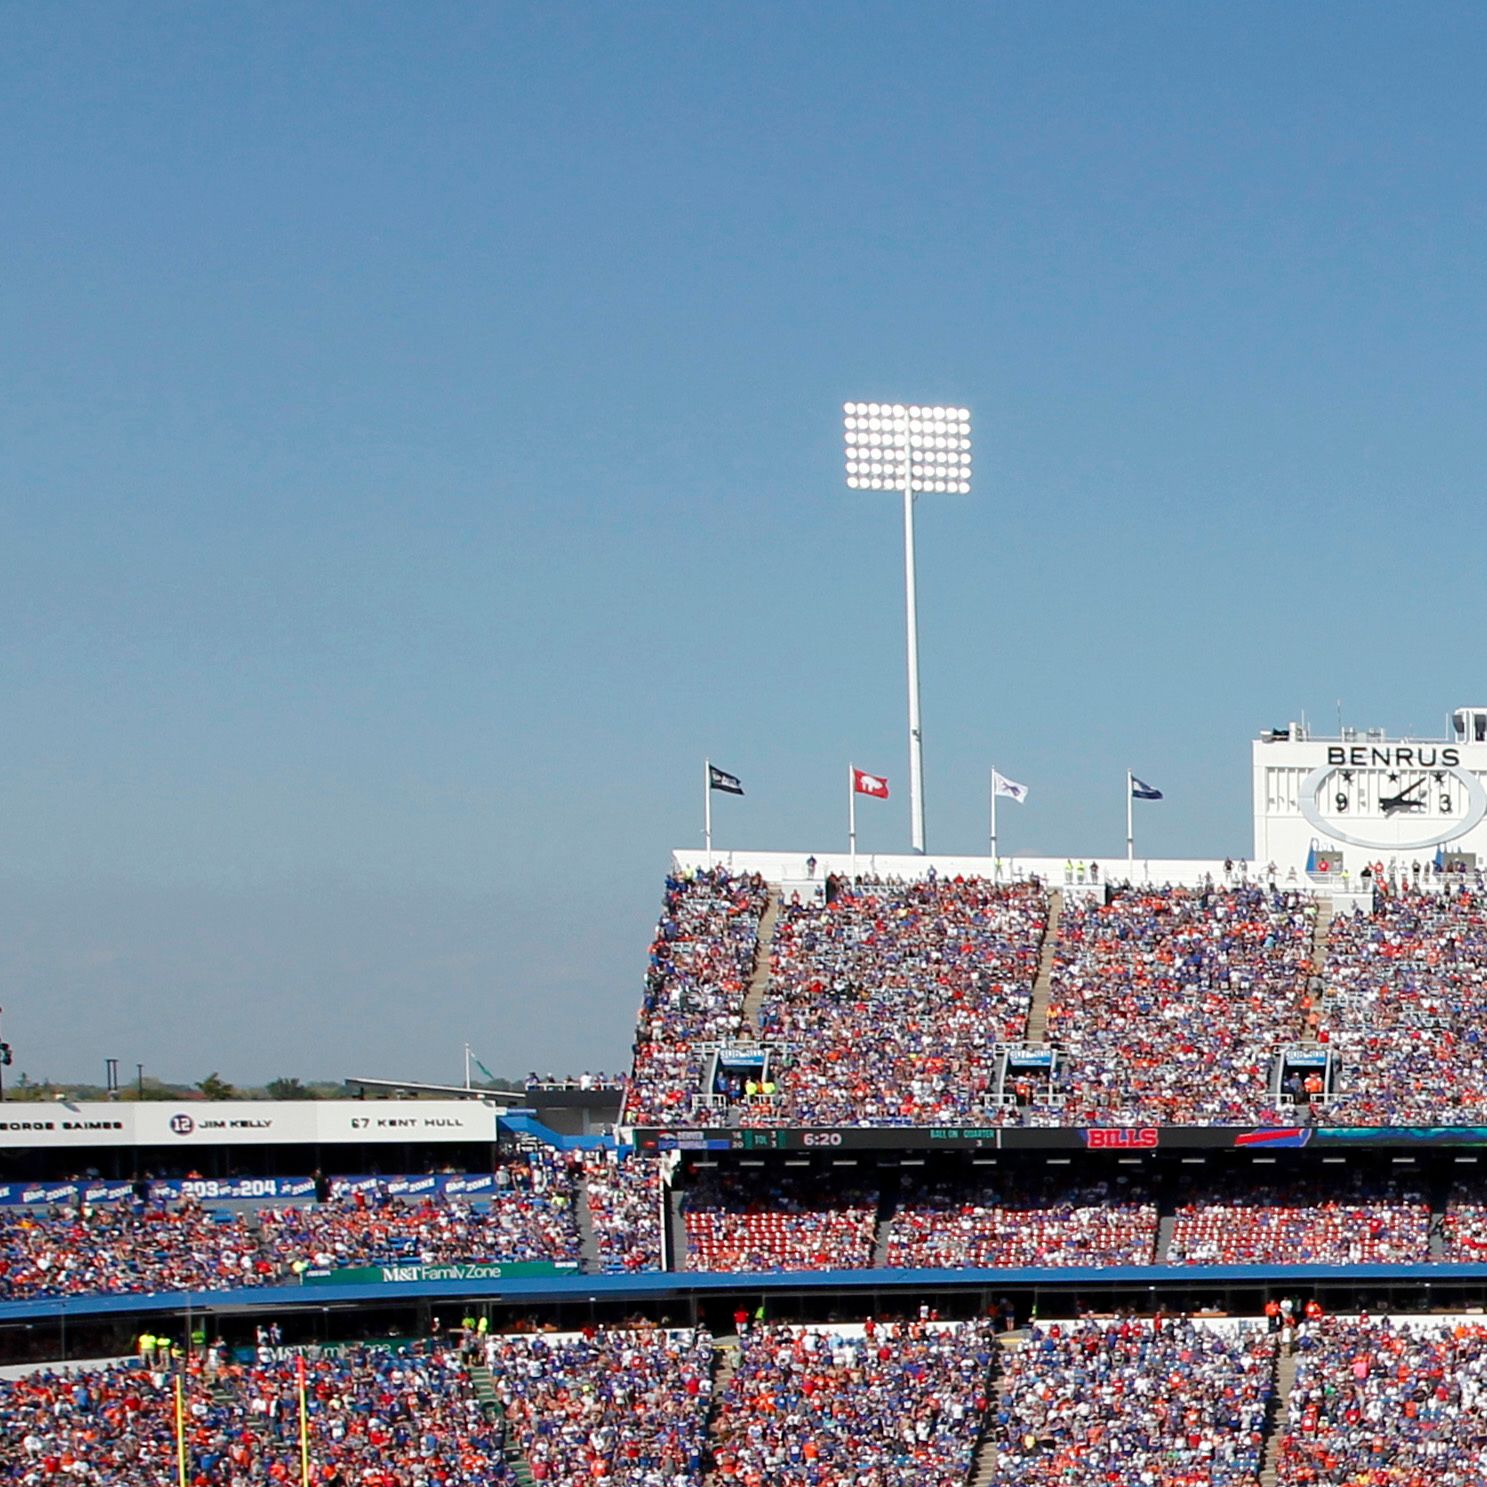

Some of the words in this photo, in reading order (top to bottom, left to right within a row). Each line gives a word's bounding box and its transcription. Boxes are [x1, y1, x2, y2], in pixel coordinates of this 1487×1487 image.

[1327, 747, 1460, 767] BENRUS
[1336, 793, 1348, 812] 9
[1440, 794, 1452, 812] 3
[174, 1117, 192, 1131] 12
[199, 1121, 226, 1129] JIM
[230, 1119, 273, 1129] KELLY
[377, 1119, 418, 1127] KENT
[424, 1118, 463, 1127] HULL
[803, 1133, 842, 1146] 6:20
[963, 1130, 994, 1139] QUARTER
[1087, 1128, 1159, 1148] BILLS
[181, 1180, 219, 1197] 203
[240, 1180, 277, 1196] 204
[382, 1267, 421, 1282] M&T
[421, 1264, 466, 1282] Family
[466, 1264, 501, 1280] Zone
